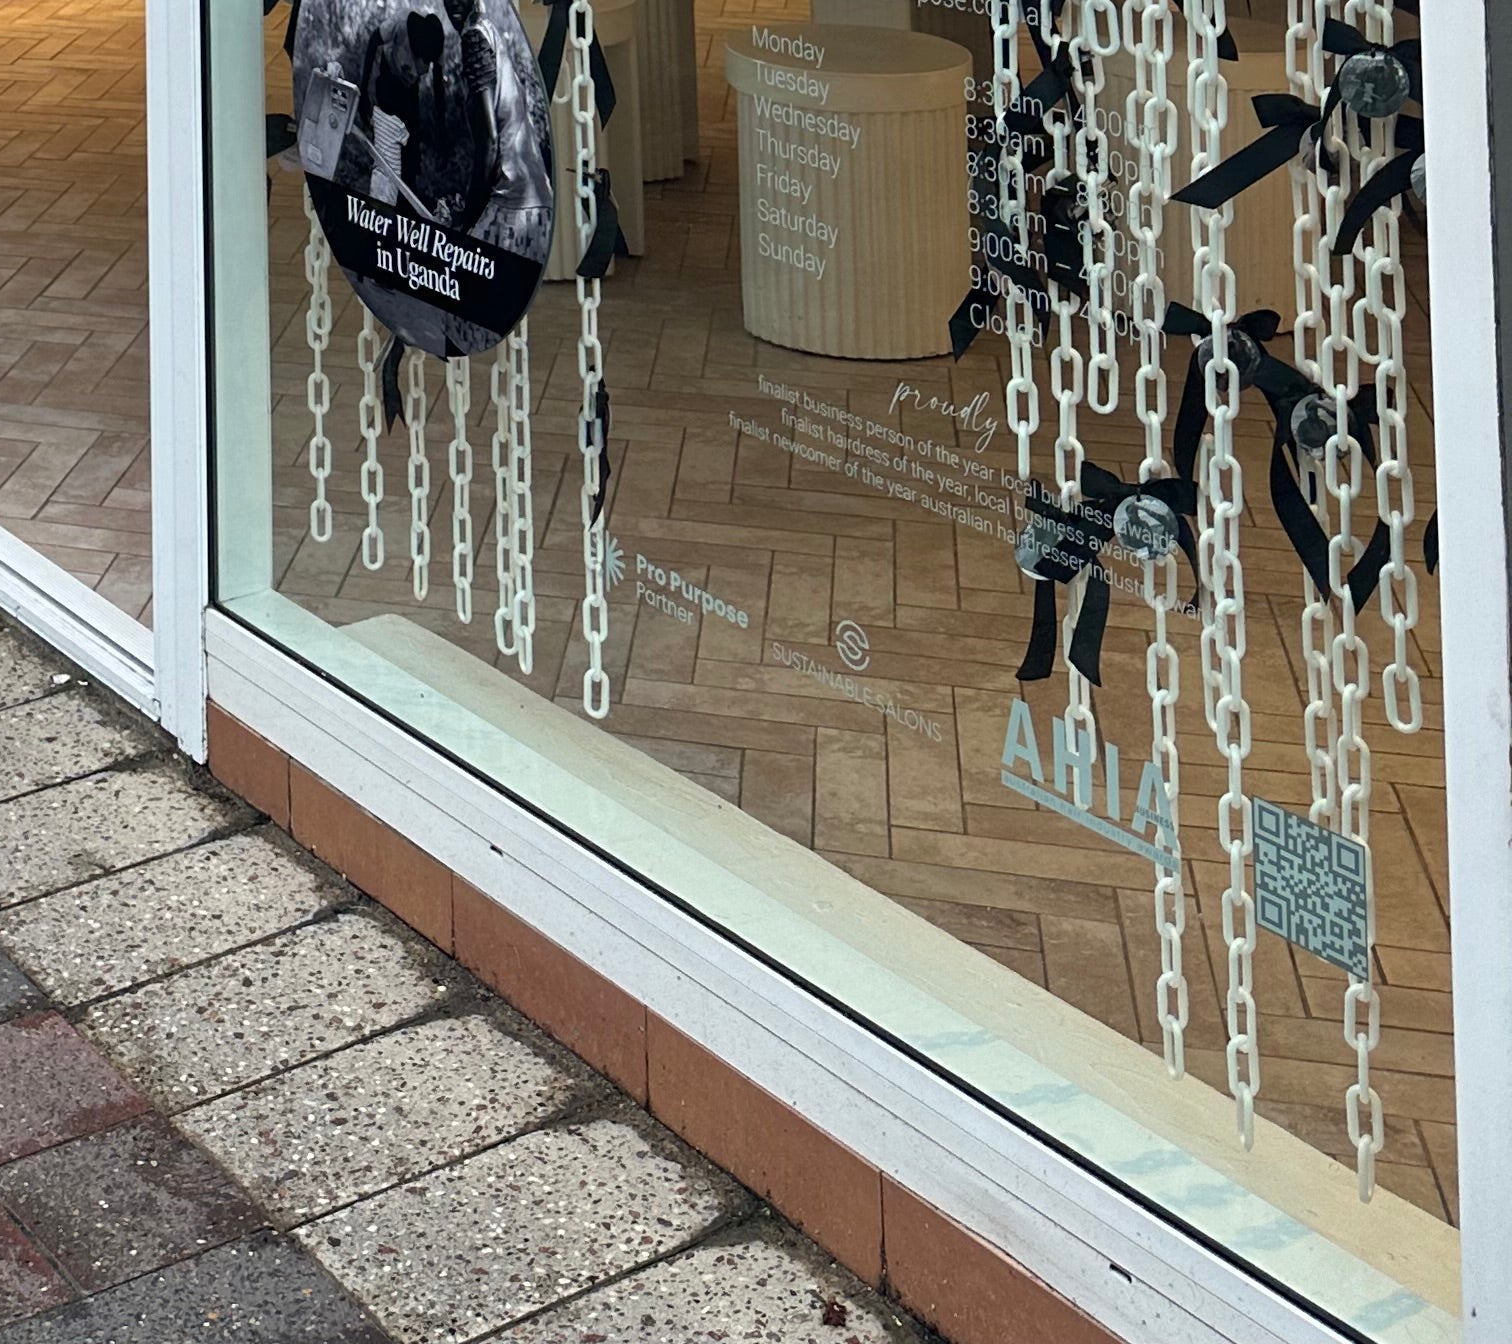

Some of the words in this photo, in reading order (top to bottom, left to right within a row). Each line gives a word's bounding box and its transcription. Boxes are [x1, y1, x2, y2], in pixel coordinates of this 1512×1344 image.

[751, 24, 826, 69] Monday
[752, 58, 830, 106] Tuesday
[752, 93, 862, 150] Wednesday
[753, 127, 841, 179] Thursday
[755, 163, 812, 205] Friday
[346, 194, 393, 237] Water
[396, 214, 431, 254] Well
[432, 229, 496, 280] Repairs
[756, 198, 839, 249] Saturday
[377, 241, 394, 273] in
[397, 248, 461, 301] Uganda
[757, 232, 826, 281] Sunday
[757, 374, 801, 405] finalist
[803, 391, 863, 431] business
[866, 419, 914, 452] person
[918, 439, 933, 457] of
[936, 445, 960, 469] the
[962, 457, 995, 482] year
[1000, 468, 1037, 500] local
[888, 380, 1000, 454] proudly
[729, 410, 770, 444] finalist
[772, 431, 842, 471] newcomer
[844, 460, 860, 480] of
[861, 467, 885, 491] the
[886, 478, 918, 503] year
[920, 492, 994, 535] australian
[781, 407, 825, 441] finalist
[827, 426, 889, 467] hairdress
[893, 454, 908, 473] of
[911, 461, 934, 485] the
[936, 474, 973, 502] year,
[975, 483, 1011, 517] local
[1013, 504, 1085, 546] business
[635, 553, 667, 586] Pro
[669, 571, 750, 630] Purpose
[636, 581, 694, 626] Partner
[875, 693, 943, 743] SALONS
[1001, 697, 1180, 853] AHIA
